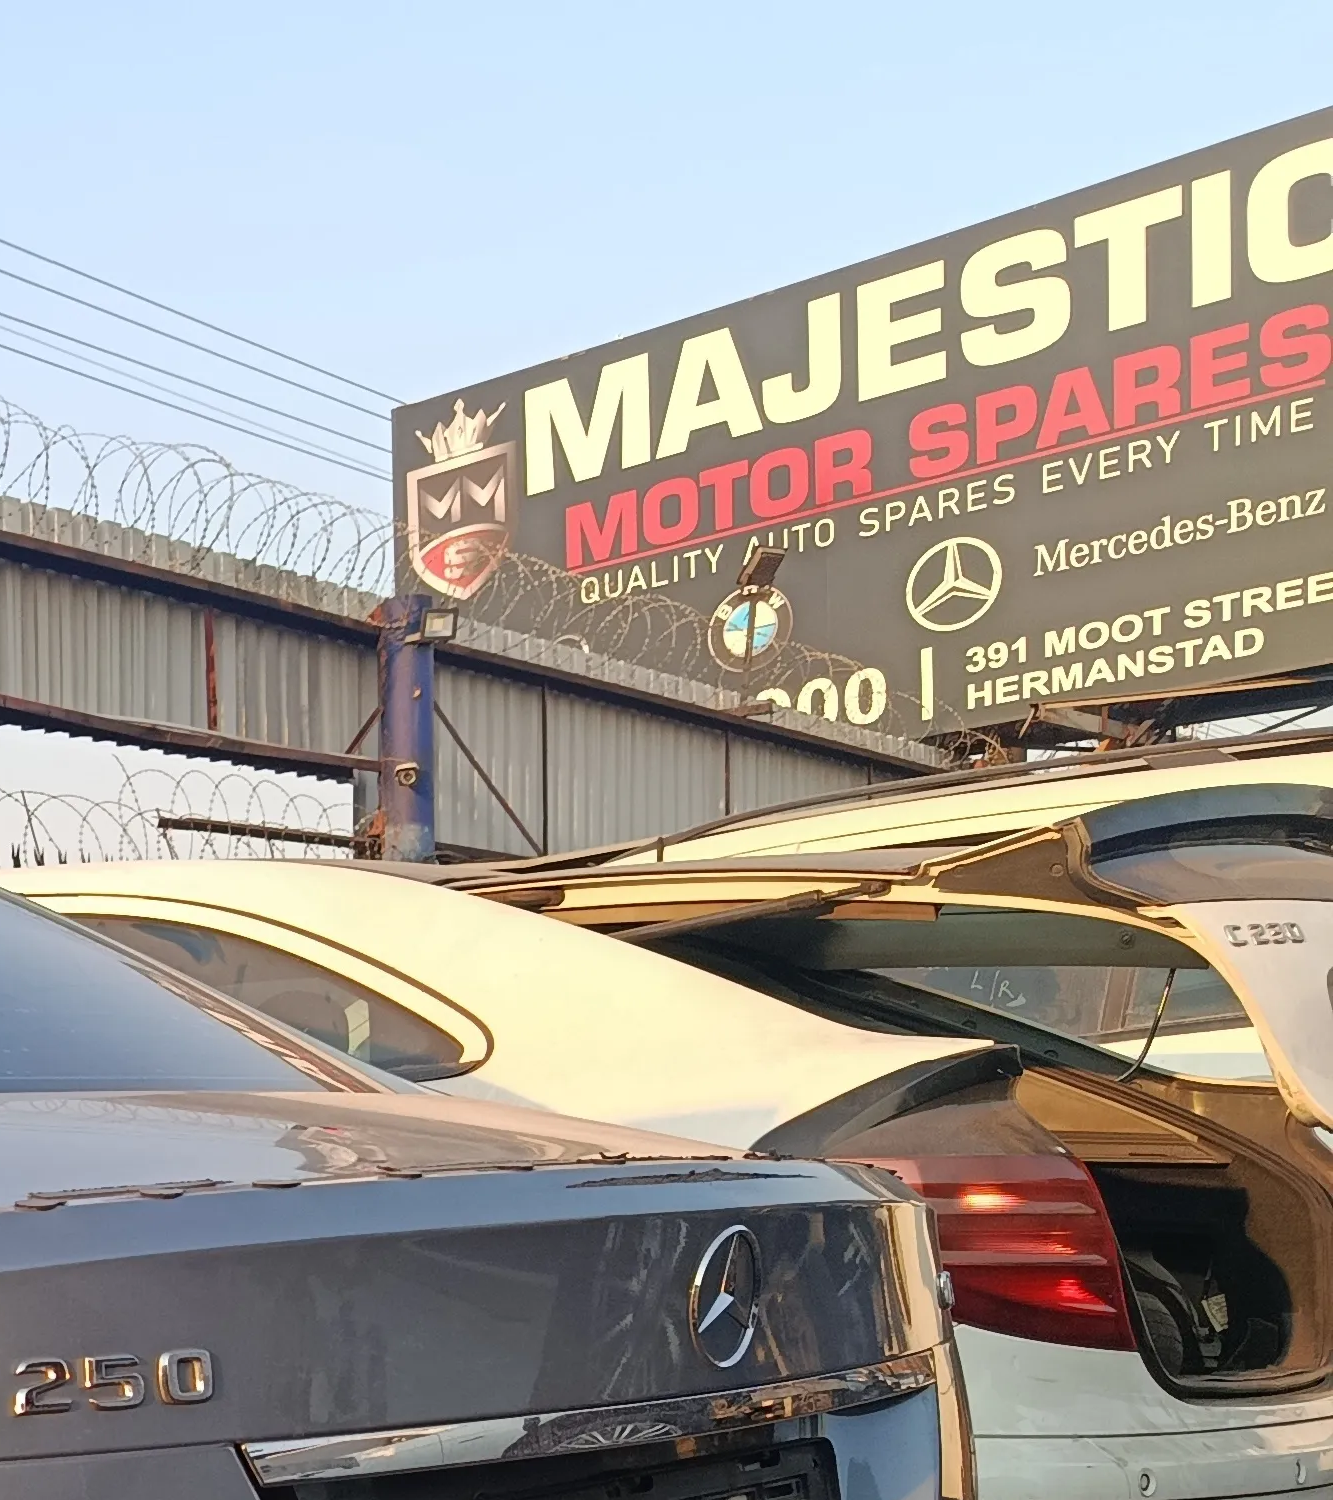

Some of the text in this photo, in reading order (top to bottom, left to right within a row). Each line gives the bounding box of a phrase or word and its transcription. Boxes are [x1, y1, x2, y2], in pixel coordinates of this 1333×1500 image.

[524, 137, 1333, 496] MAJESTIC
[565, 303, 1332, 568] MOTOR SPARES
[581, 545, 724, 604] QUALITY
[858, 474, 1016, 537] SPARES
[1041, 430, 1181, 494] EVERY
[1203, 397, 1314, 452] TIME
[1033, 487, 1326, 577] Mercedes-Benz
[965, 571, 1333, 673] 391 MOOT STREE
[967, 627, 1265, 710] HERMANSTAD
[1223, 924, 1249, 947] C
[13, 1348, 215, 1418] 250
